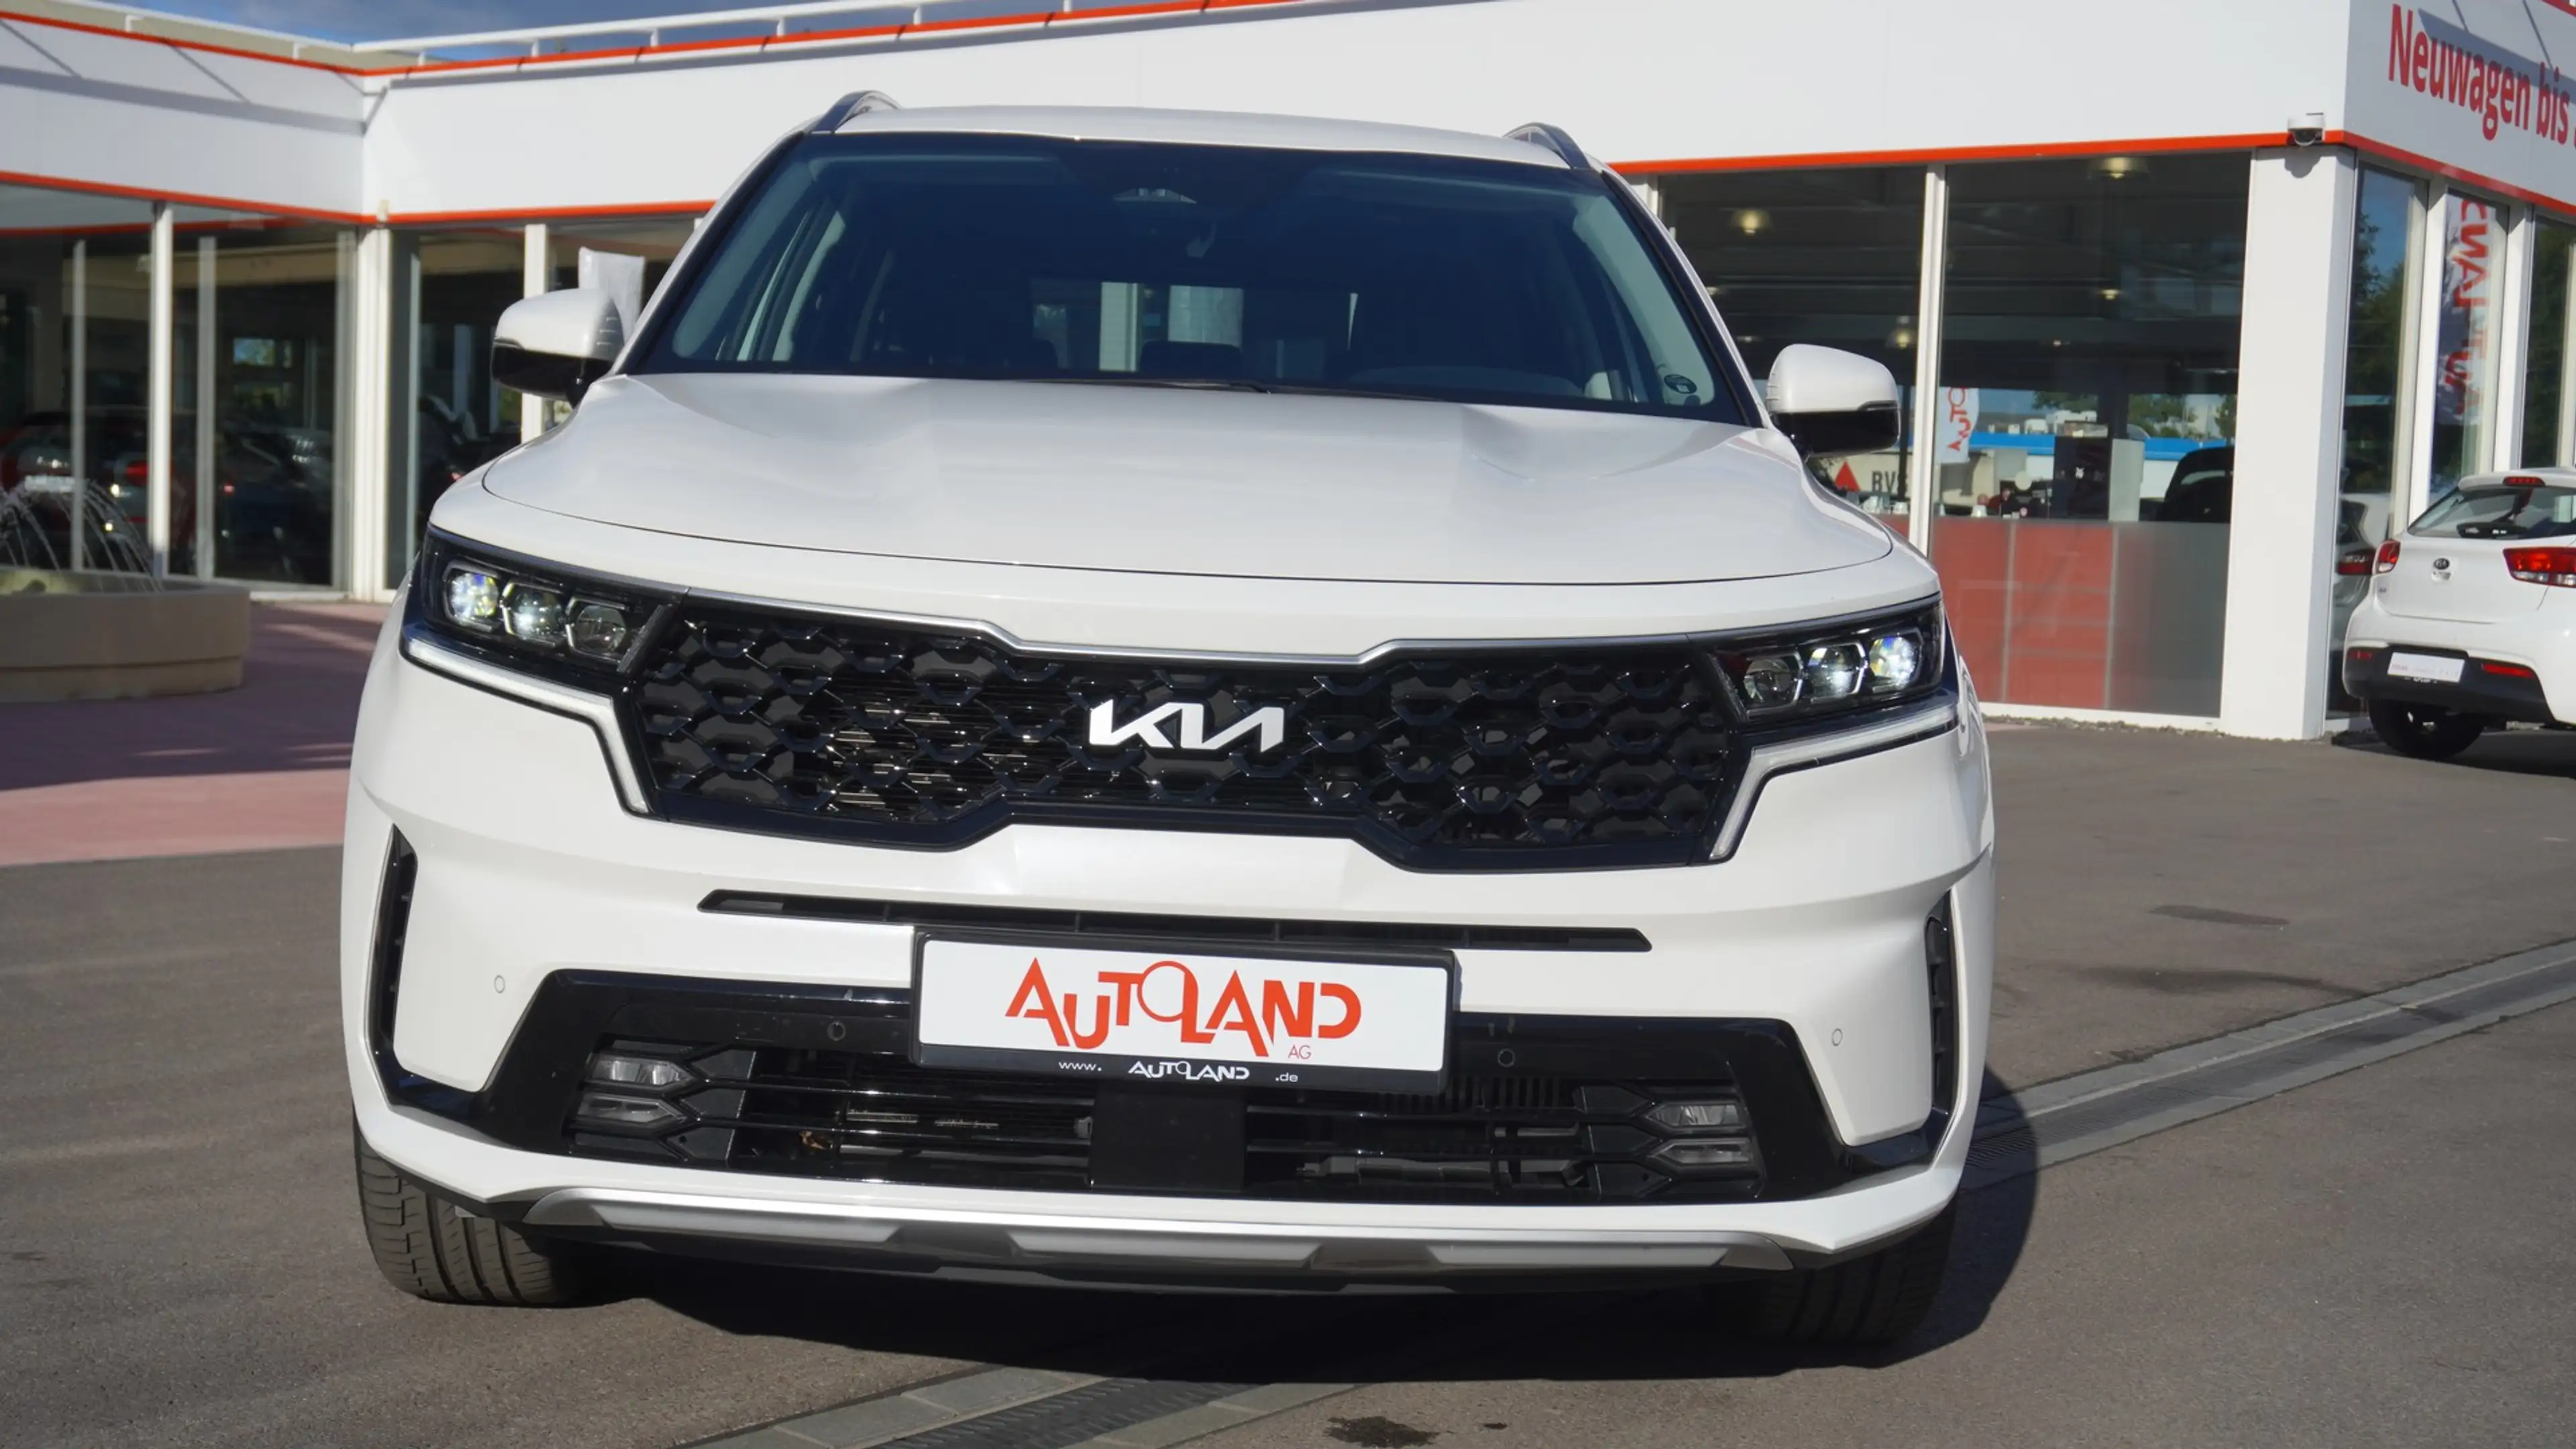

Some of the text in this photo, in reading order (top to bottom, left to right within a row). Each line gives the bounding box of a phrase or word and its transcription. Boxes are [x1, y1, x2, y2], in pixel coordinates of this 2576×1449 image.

[2388, 3, 2571, 146] Neuwagen bis
[1005, 957, 1362, 1058] AUTOLAND
[1058, 1060, 1299, 1083] www. AUTOLAND .de
[1288, 1044, 1312, 1060] AG
